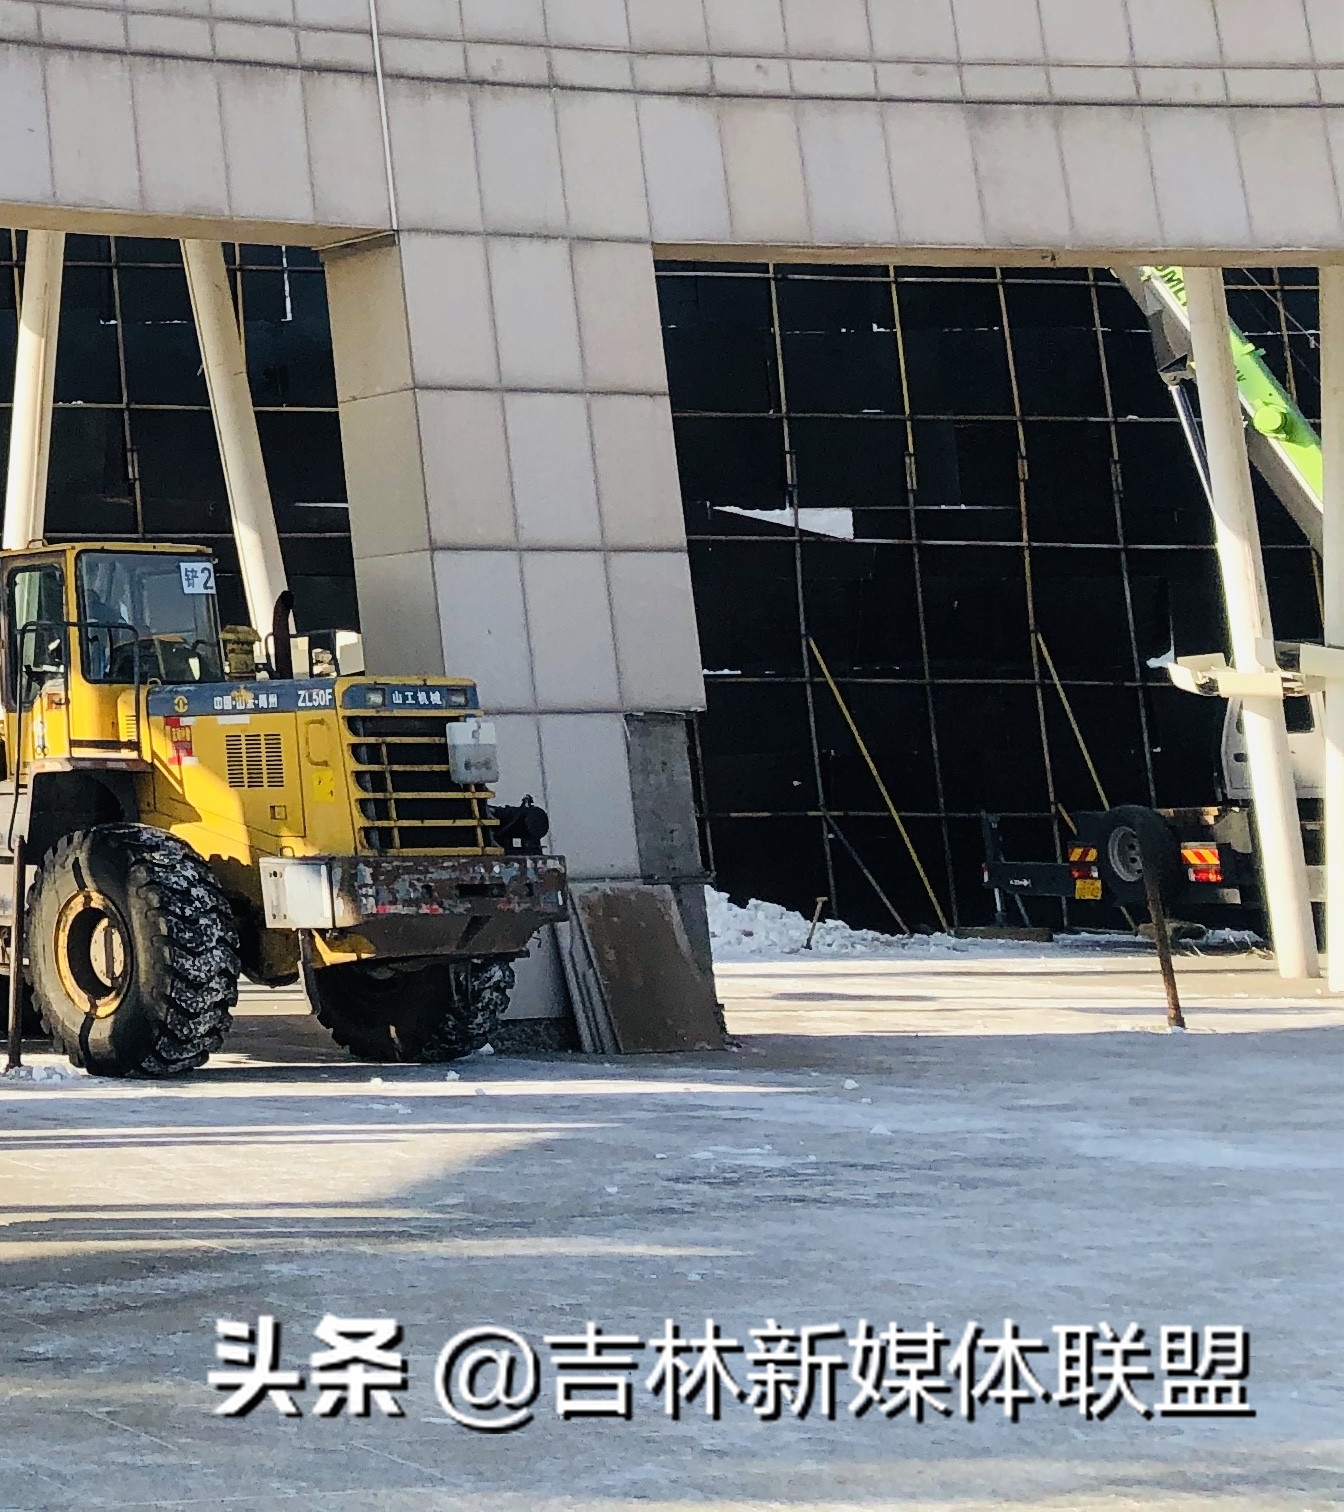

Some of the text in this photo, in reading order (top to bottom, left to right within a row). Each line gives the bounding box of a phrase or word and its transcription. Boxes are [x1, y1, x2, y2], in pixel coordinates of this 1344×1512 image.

[297, 688, 333, 707] ZL50F
[392, 689, 443, 705] 山工机械
